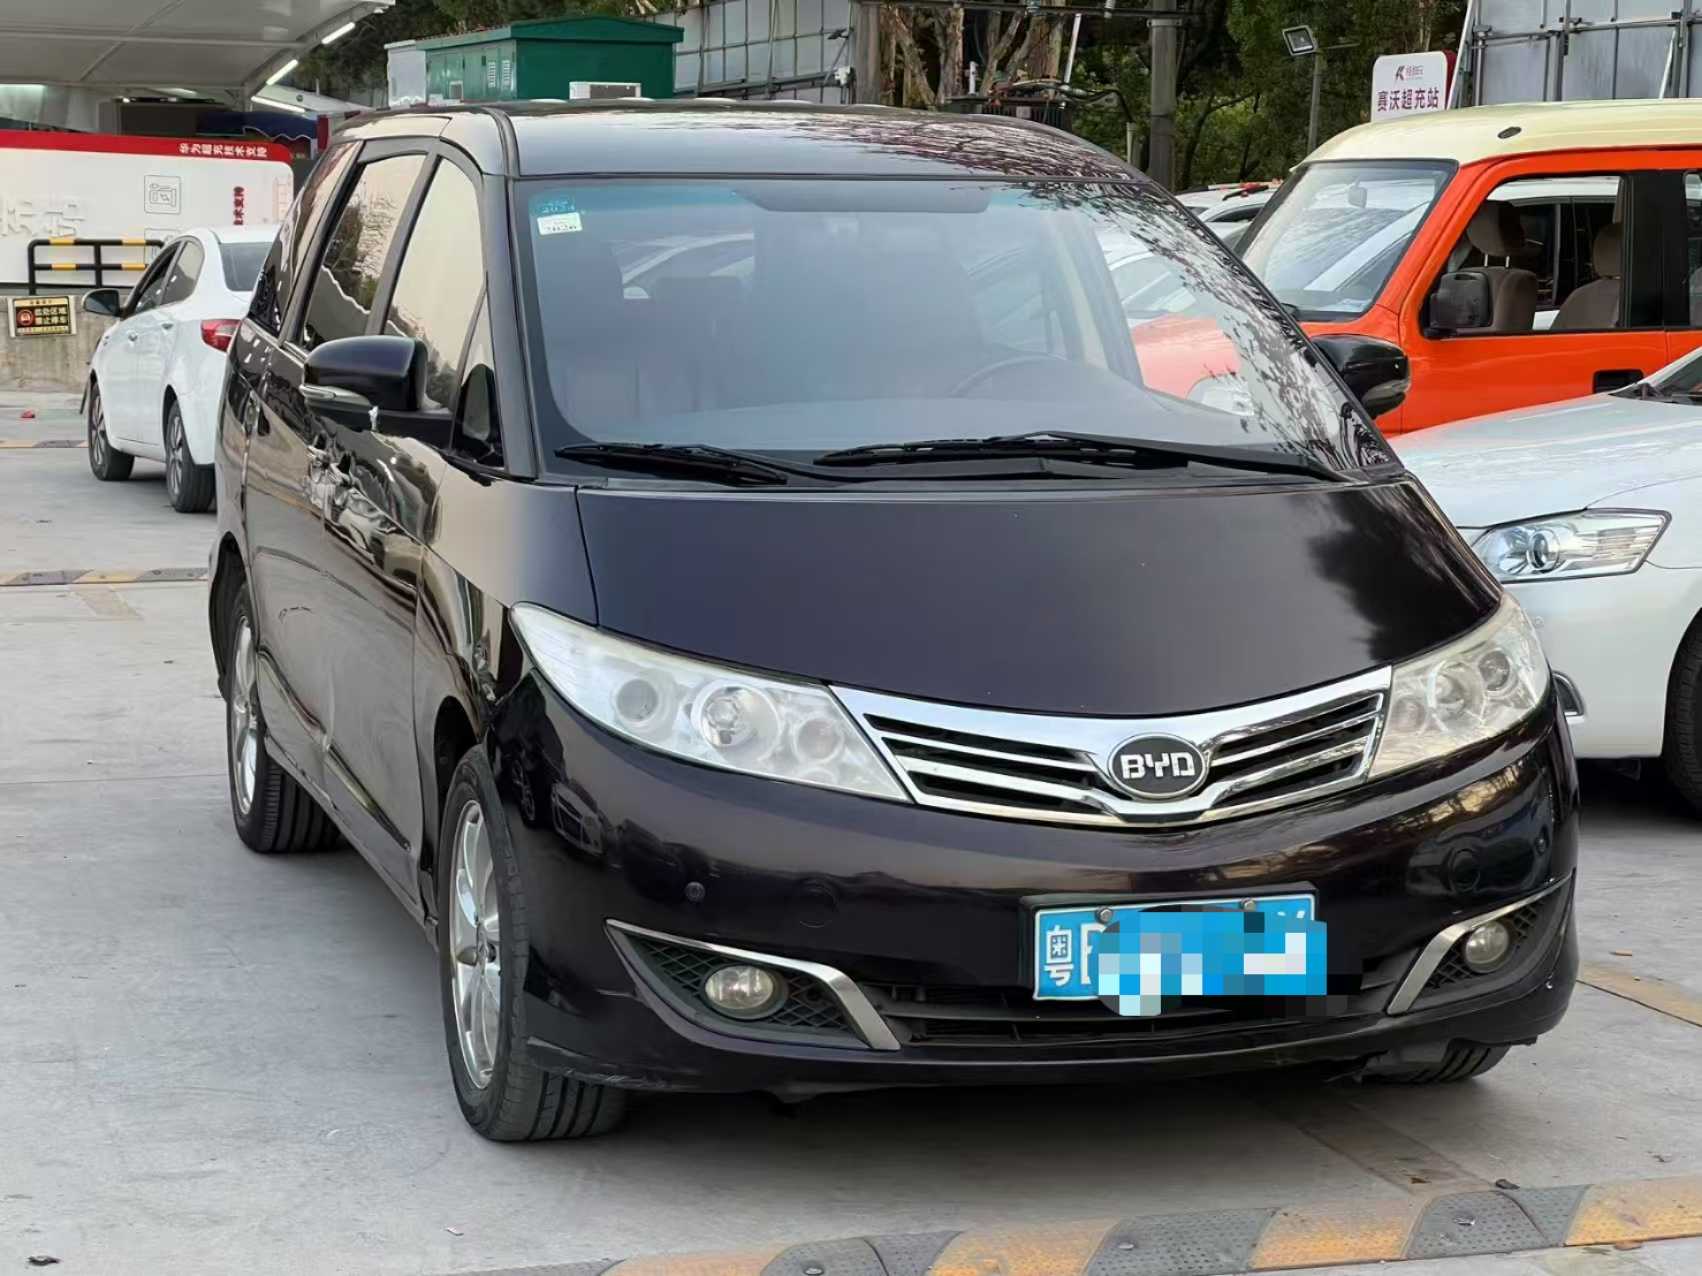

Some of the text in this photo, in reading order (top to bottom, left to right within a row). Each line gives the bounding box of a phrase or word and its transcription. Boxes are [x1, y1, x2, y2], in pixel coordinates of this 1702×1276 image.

[1377, 87, 1439, 112] 赛沃超充站
[1120, 752, 1196, 779] BYD
